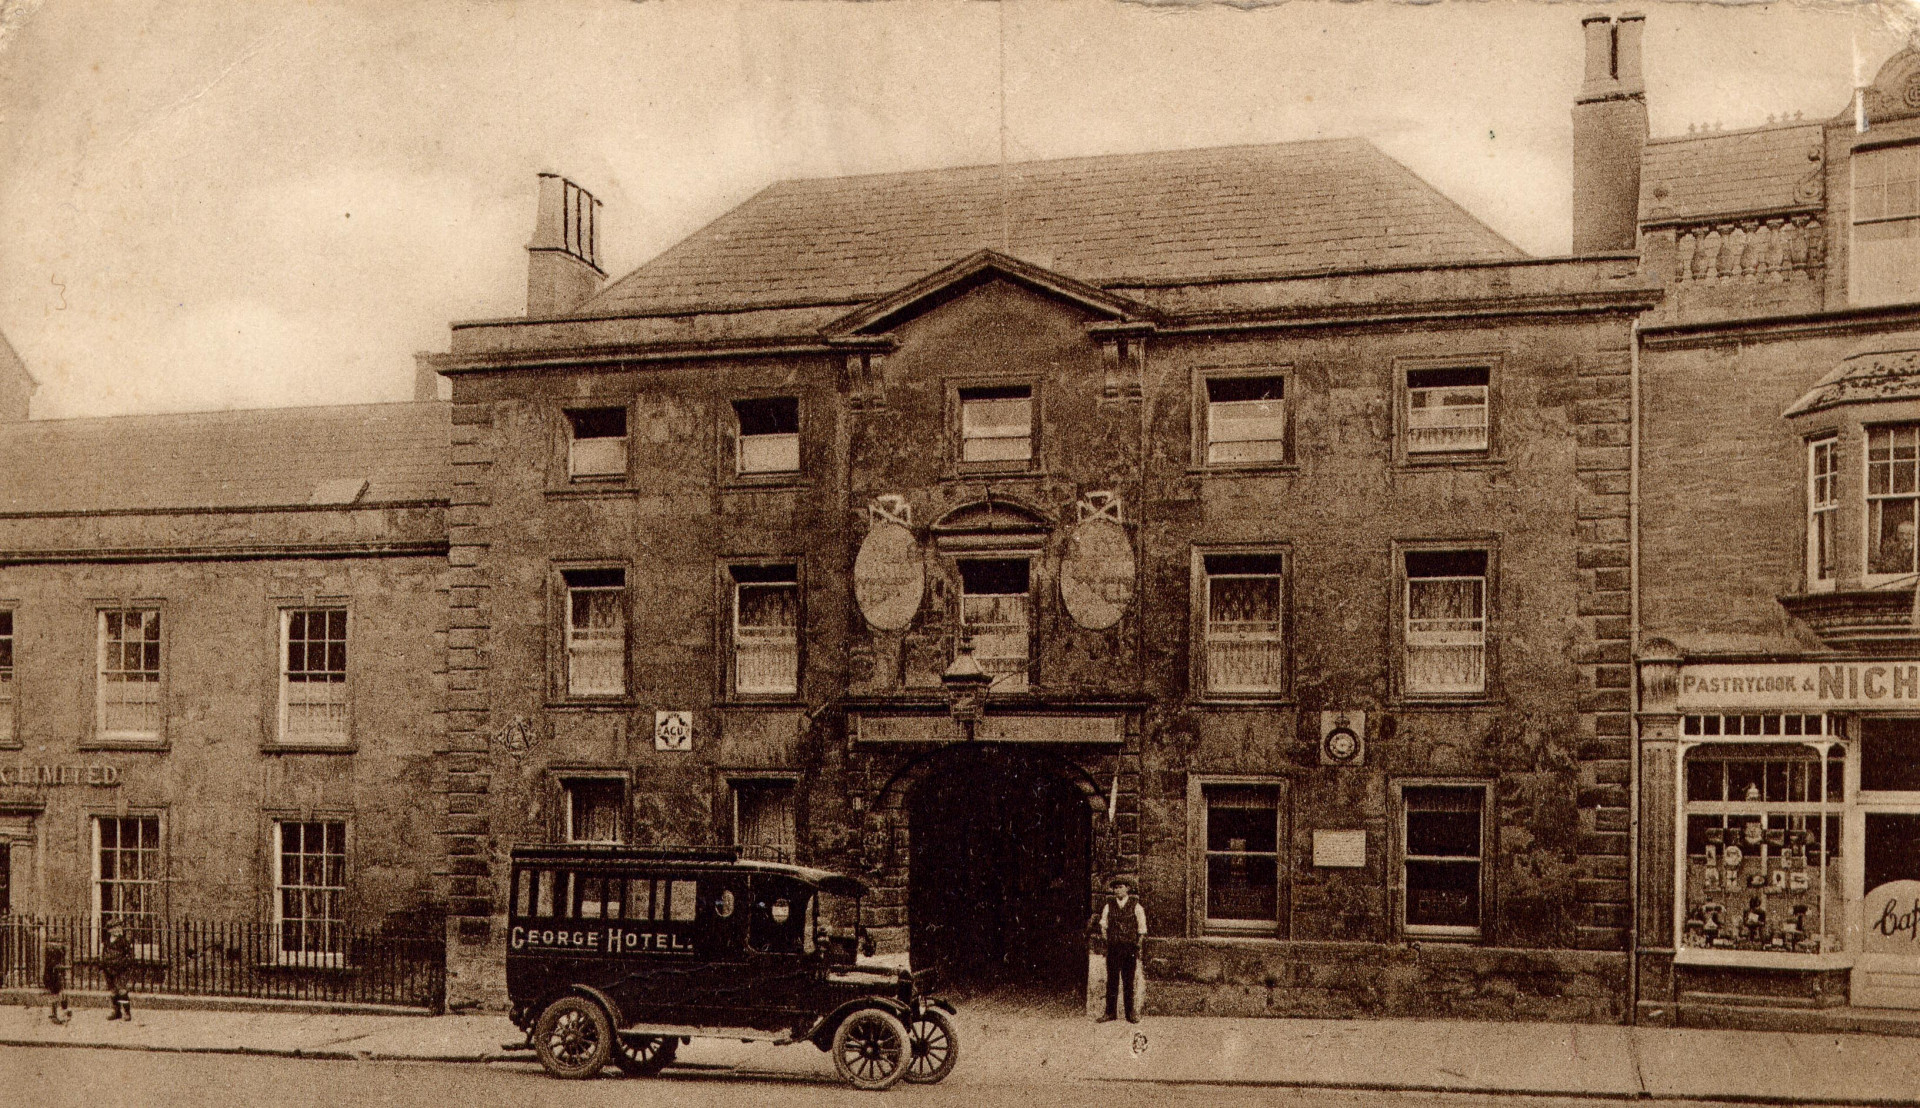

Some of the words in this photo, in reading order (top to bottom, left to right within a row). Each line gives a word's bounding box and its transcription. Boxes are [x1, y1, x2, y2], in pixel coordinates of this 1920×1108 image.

[1683, 675, 1796, 693] PASTRYCOOK
[1801, 677, 1815, 691] &
[1819, 665, 1918, 699] NICH
[19, 765, 118, 784] LIMITED
[511, 926, 599, 949] GEORGE
